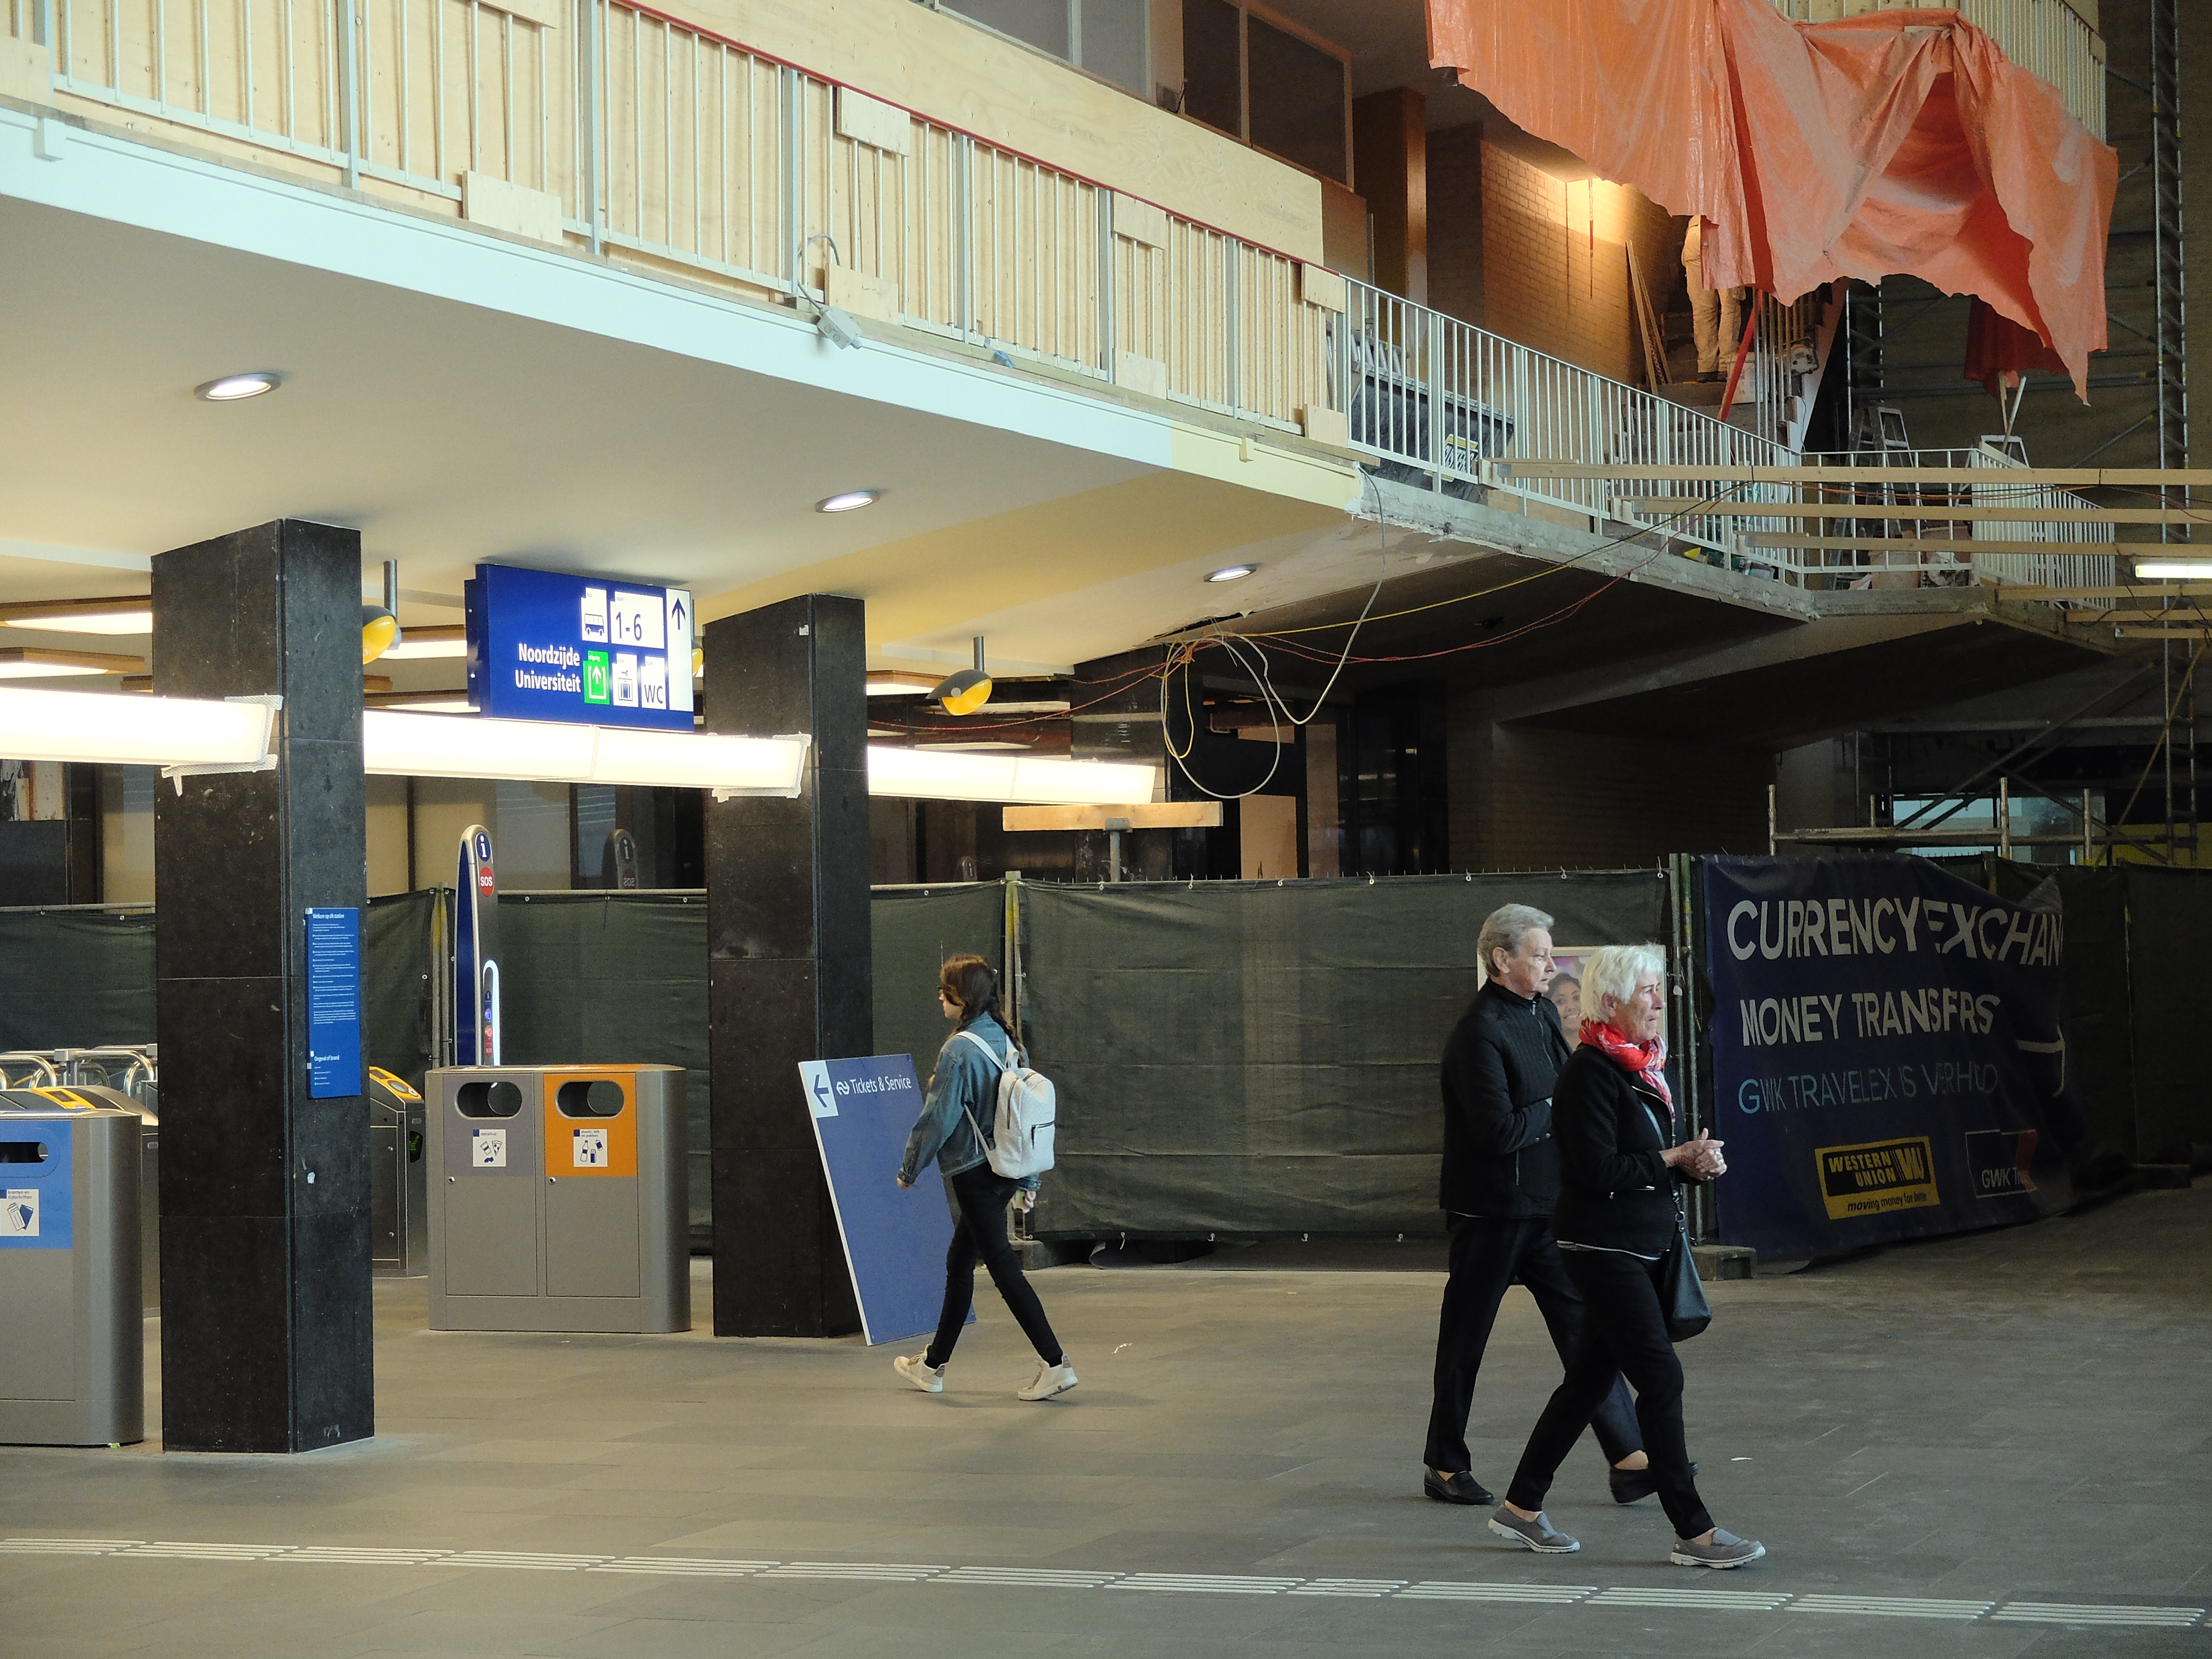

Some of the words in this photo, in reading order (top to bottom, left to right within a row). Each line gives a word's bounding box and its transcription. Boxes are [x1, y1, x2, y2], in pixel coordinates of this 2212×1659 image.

[615, 612, 642, 641] 1-6
[518, 643, 580, 670] Noordzijde
[515, 670, 581, 693] Universiteit
[644, 684, 664, 704] WC
[480, 877, 493, 886] SOS
[1727, 896, 1920, 961] CURRENCY
[1923, 899, 2064, 967] EXCHAN
[1740, 994, 1843, 1047] MONEY
[849, 1078, 878, 1094] Tickets
[878, 1076, 885, 1092] &
[885, 1074, 912, 1092] Service
[1738, 1078, 1787, 1114] GWK
[1787, 1067, 1898, 1109] TRAVELEX
[1898, 1065, 1917, 1098] IS
[1828, 1150, 1892, 1173] WESTERN
[1854, 1167, 1897, 1187] UNION
[1981, 1167, 2011, 1188] GWK
[1847, 1198, 1880, 1212] moving
[1881, 1196, 1903, 1207] money
